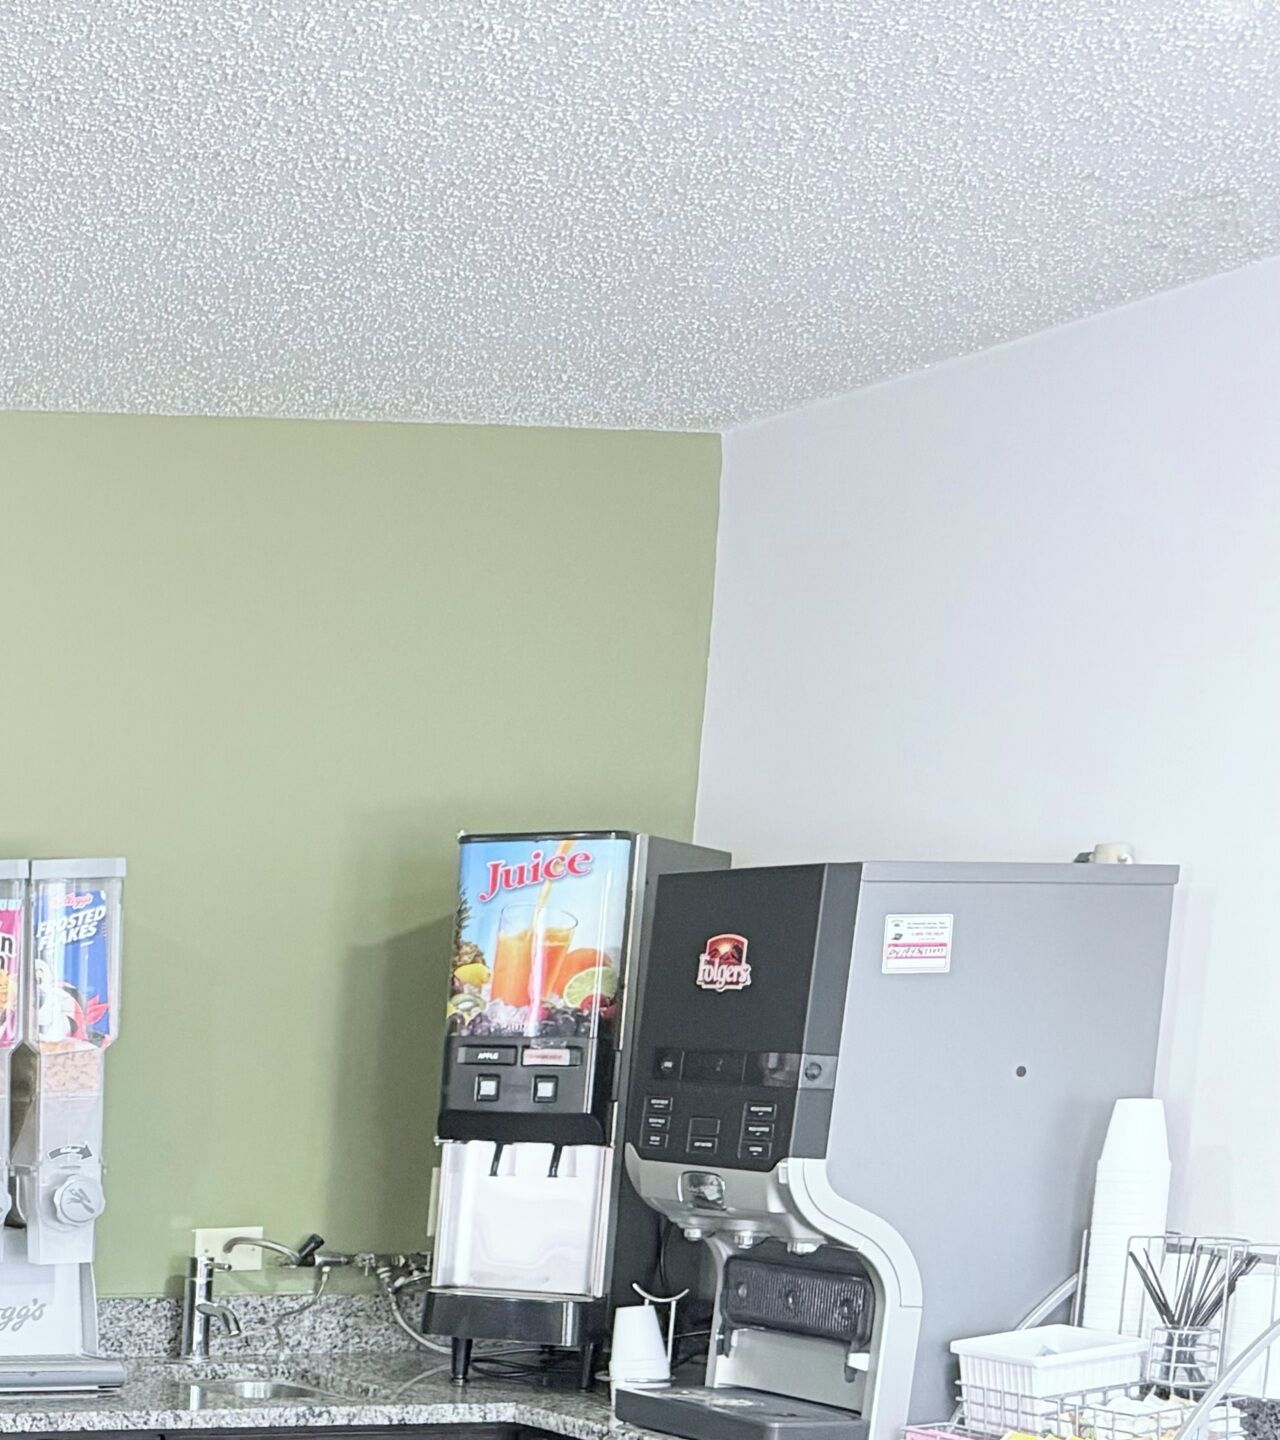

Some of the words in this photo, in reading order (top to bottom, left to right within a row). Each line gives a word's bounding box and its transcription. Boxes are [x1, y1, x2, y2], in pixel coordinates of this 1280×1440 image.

[478, 850, 593, 903] Juice
[36, 905, 107, 939] FROSTED
[697, 953, 748, 988] Folgers
[477, 1051, 500, 1061] APPLE
